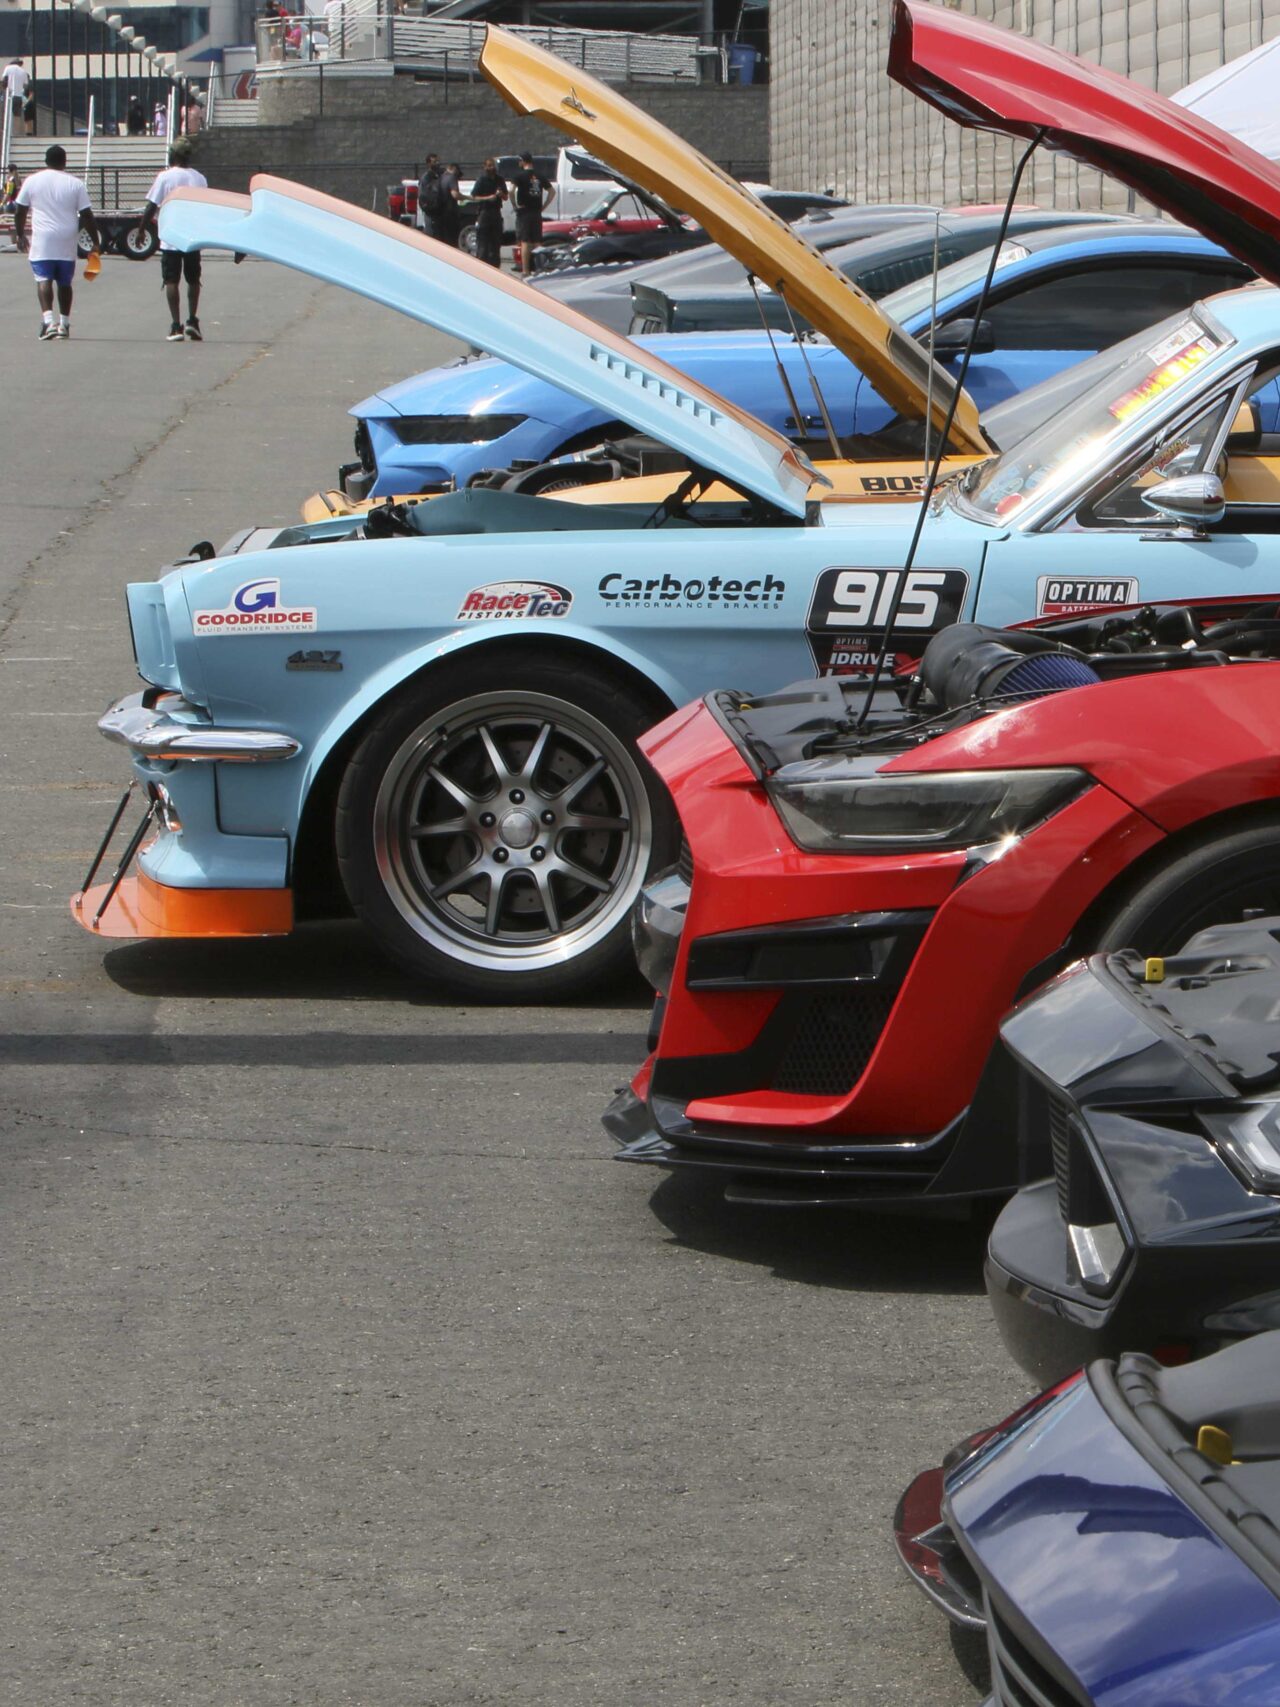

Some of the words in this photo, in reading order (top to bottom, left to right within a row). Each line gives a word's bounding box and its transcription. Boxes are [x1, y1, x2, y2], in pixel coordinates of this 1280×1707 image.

[598, 573, 785, 601] Carbotech
[1049, 583, 1124, 601] OPTIMA
[826, 571, 946, 627] 915
[197, 612, 313, 625] GOODRIDGE
[457, 611, 524, 619] PISTONS
[836, 637, 867, 645] OPTIMA
